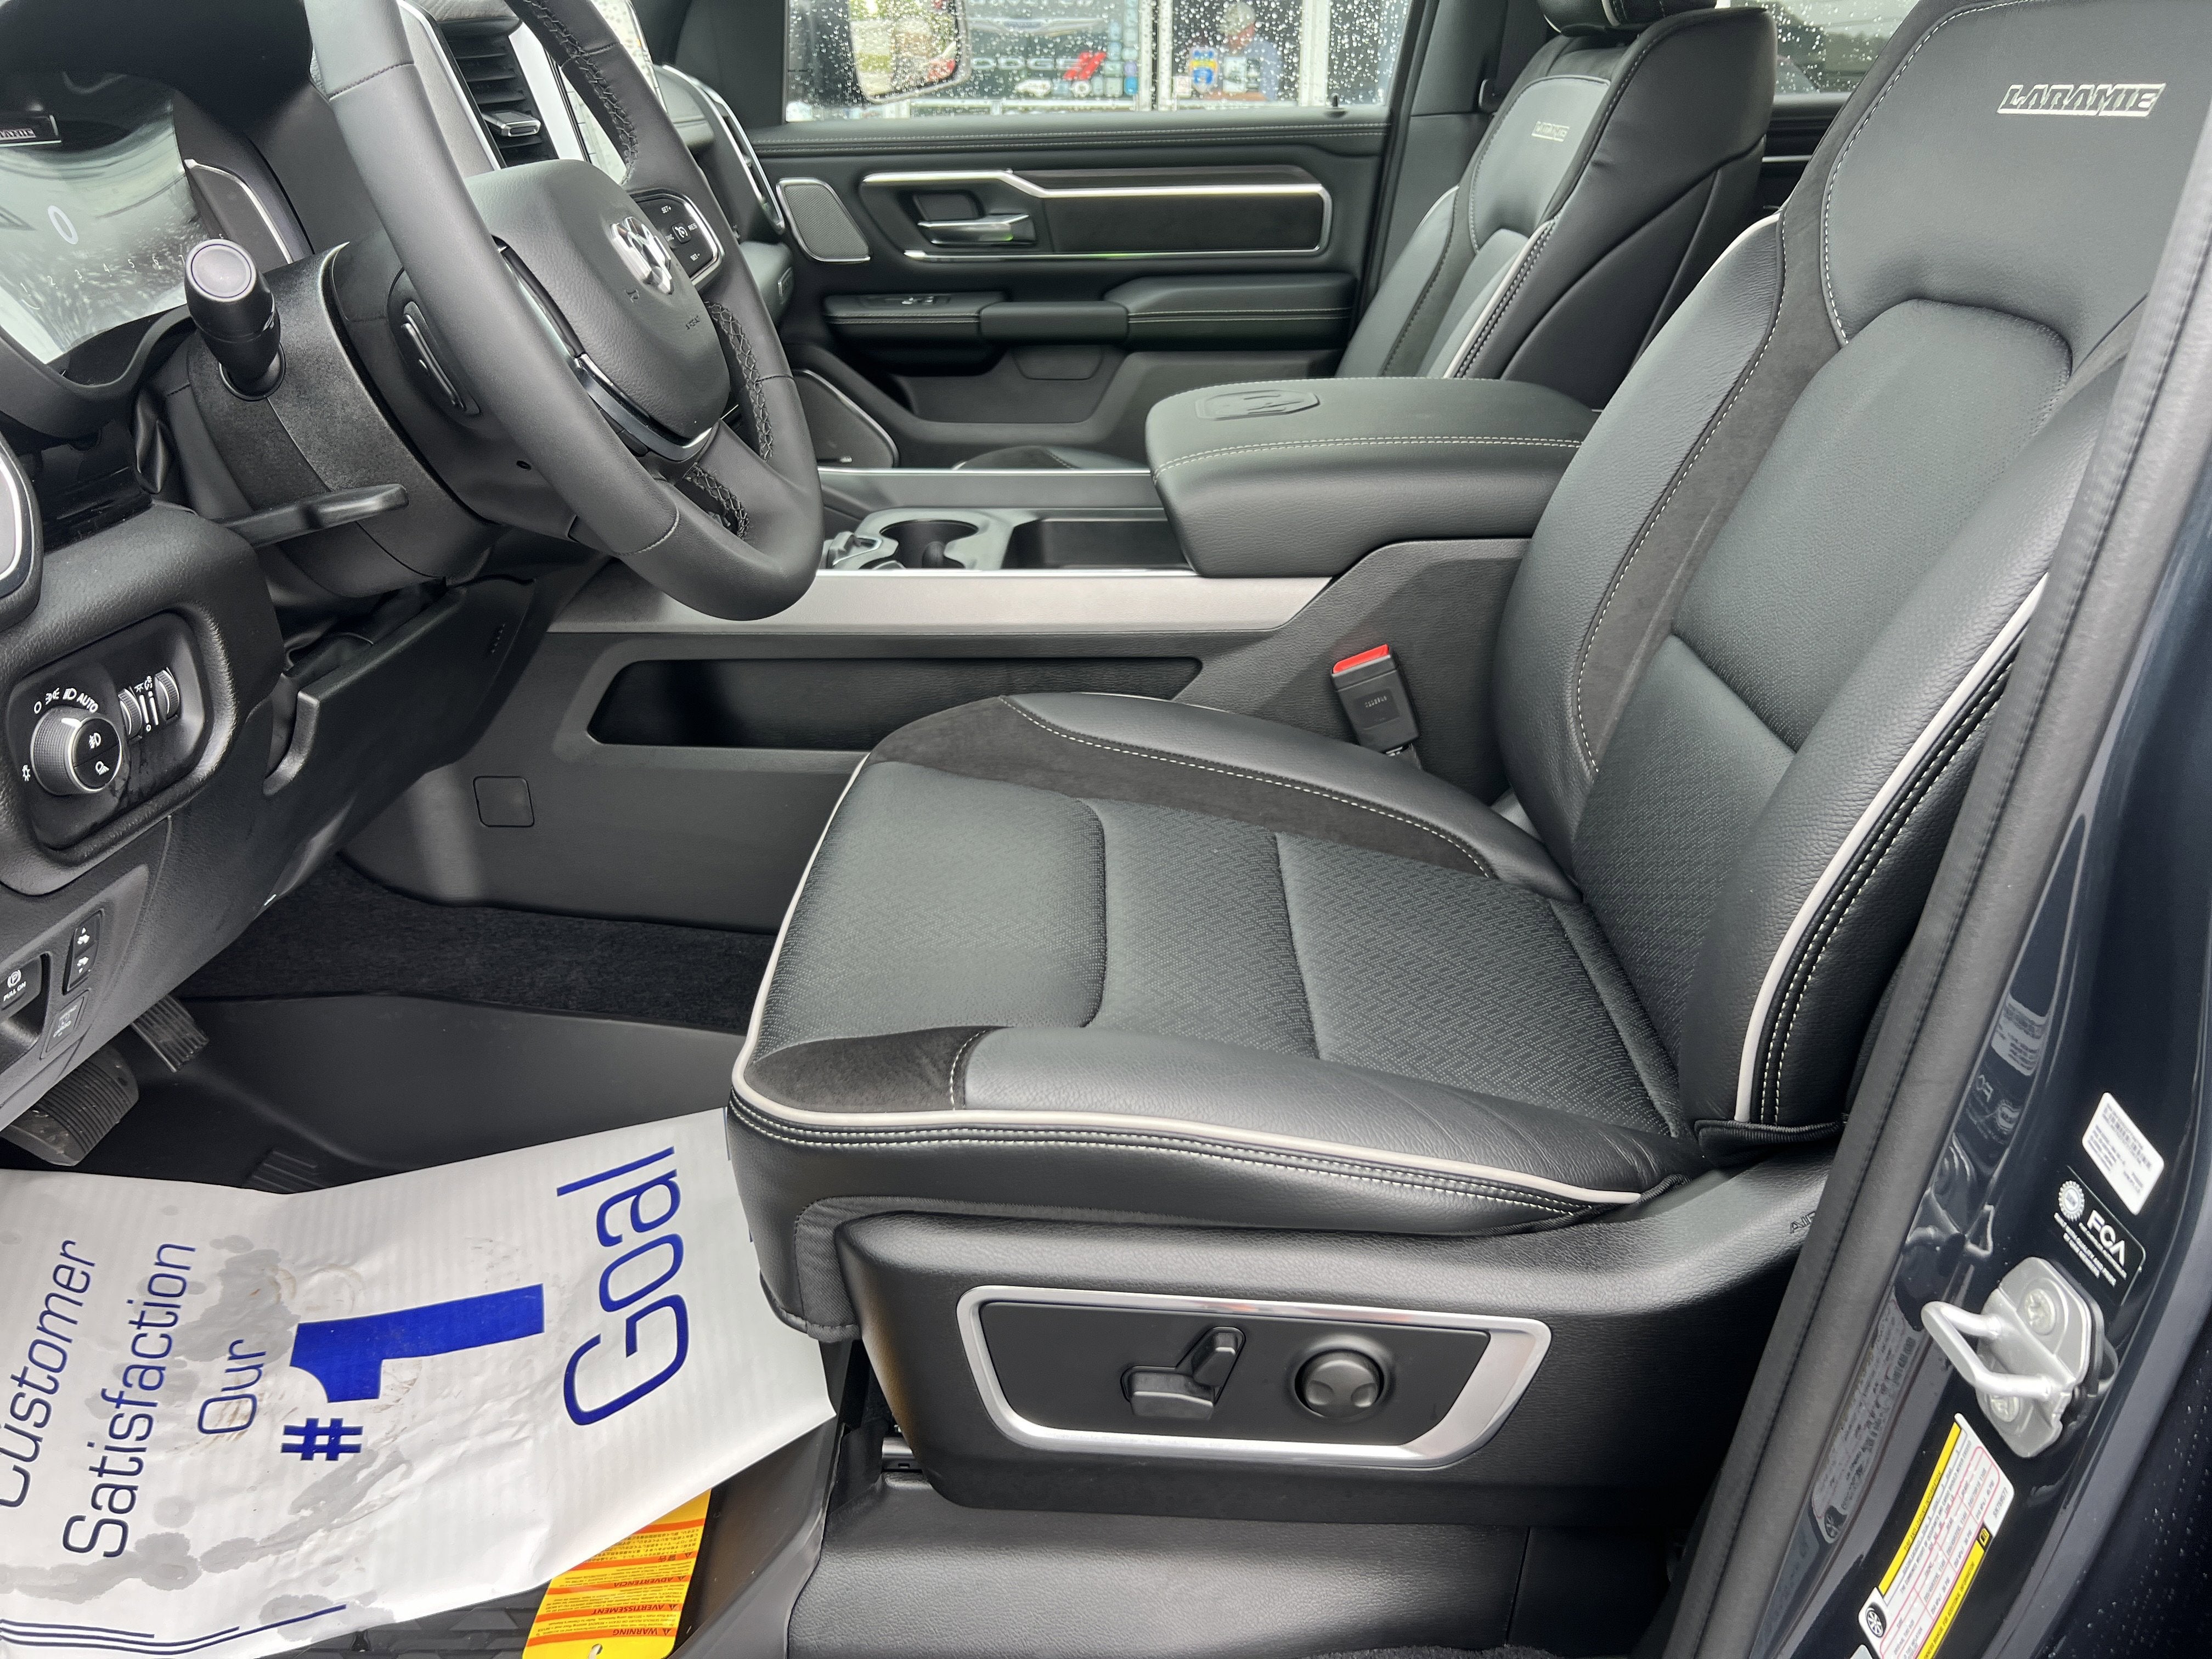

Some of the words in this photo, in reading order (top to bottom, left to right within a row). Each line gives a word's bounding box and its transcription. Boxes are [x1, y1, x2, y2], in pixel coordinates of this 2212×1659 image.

[1996, 83, 2166, 117] LARAMIE
[47, 205, 79, 245] 0
[76, 692, 99, 713] AUTO
[3, 989, 17, 1002] PULL
[17, 981, 26, 991] ON
[2086, 1209, 2125, 1266] FCA
[556, 1146, 689, 1426] Goal
[62, 1242, 196, 1558] Satisfaction
[198, 1339, 267, 1436] Our
[613, 1577, 673, 1587] ADVERTENCIA
[591, 1604, 664, 1615] AVERTISSEMENT
